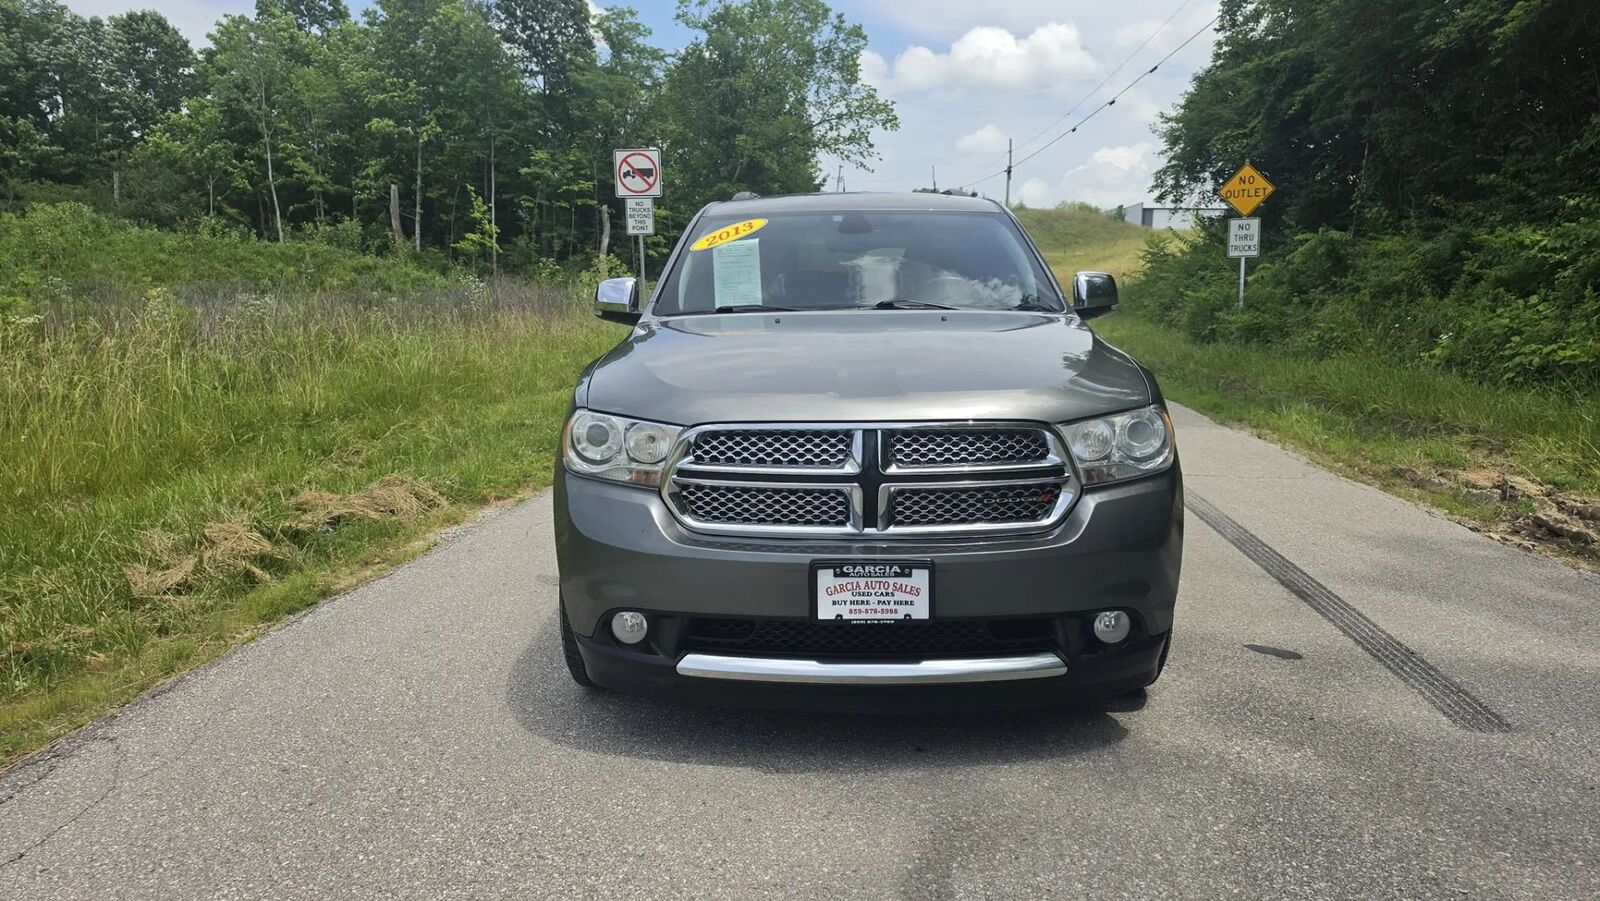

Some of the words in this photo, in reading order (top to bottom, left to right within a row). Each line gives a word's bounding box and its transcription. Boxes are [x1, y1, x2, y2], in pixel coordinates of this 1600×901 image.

[1238, 175, 1255, 185] NO
[1225, 188, 1268, 198] OUTLET
[1238, 223, 1251, 231] NO
[706, 222, 754, 247] 2013
[1230, 244, 1257, 253] TRUCKS
[825, 581, 861, 597] GARCIA
[863, 580, 890, 591] AUTO
[892, 581, 922, 597] SALES
